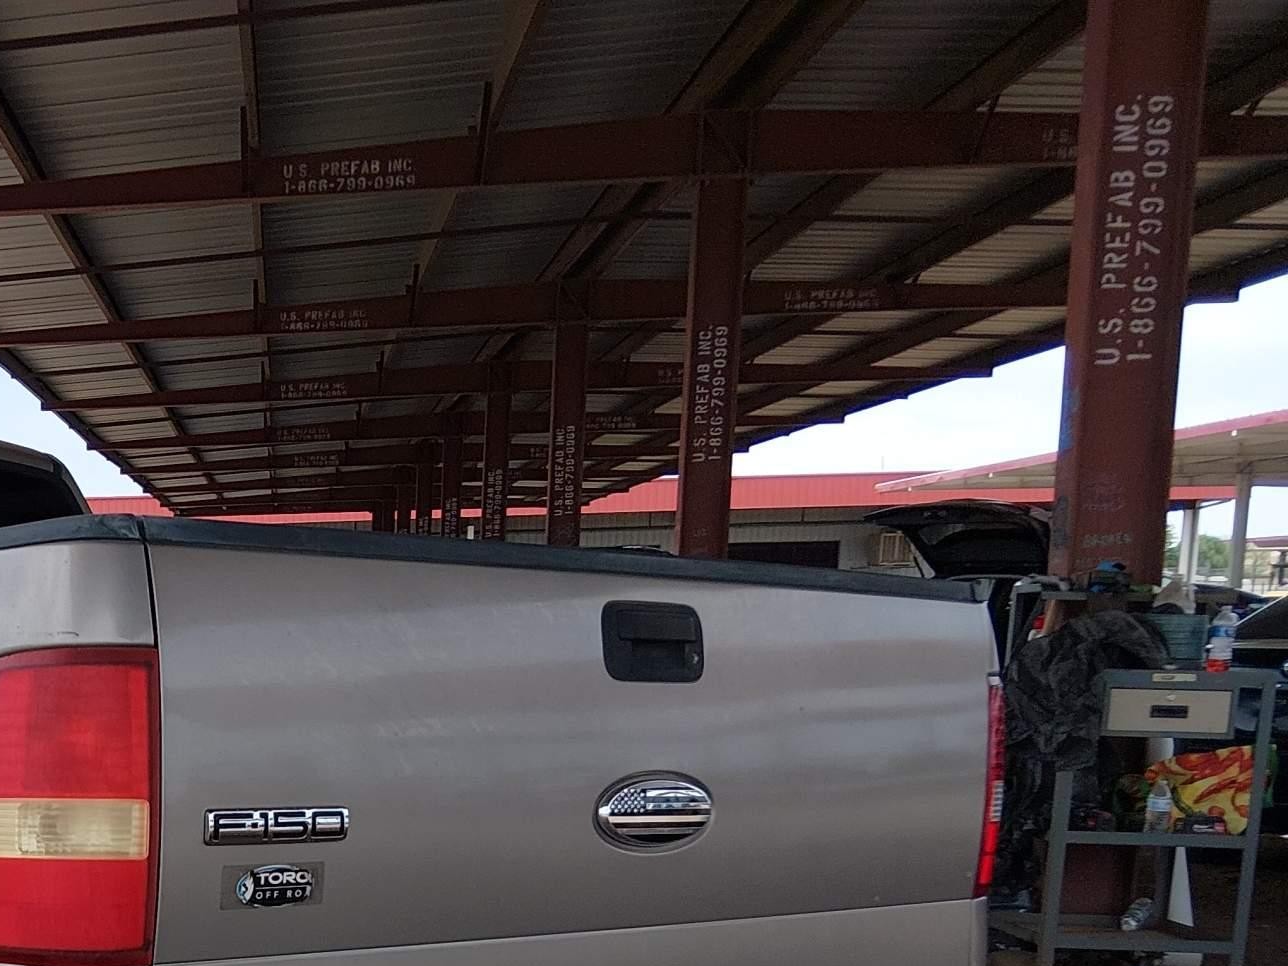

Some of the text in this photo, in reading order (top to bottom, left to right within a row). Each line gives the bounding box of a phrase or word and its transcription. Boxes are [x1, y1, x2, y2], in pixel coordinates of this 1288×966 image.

[320, 159, 381, 177] PREFAB
[1094, 93, 1143, 366] U.S. PREFAB INC.
[1125, 94, 1174, 361] 1-866-799-0969
[691, 325, 713, 463] U.S. PREFAB INC.
[707, 325, 729, 462] 1-866-799-0969
[554, 450, 565, 492] PREFAB
[255, 890, 280, 900] OFF
